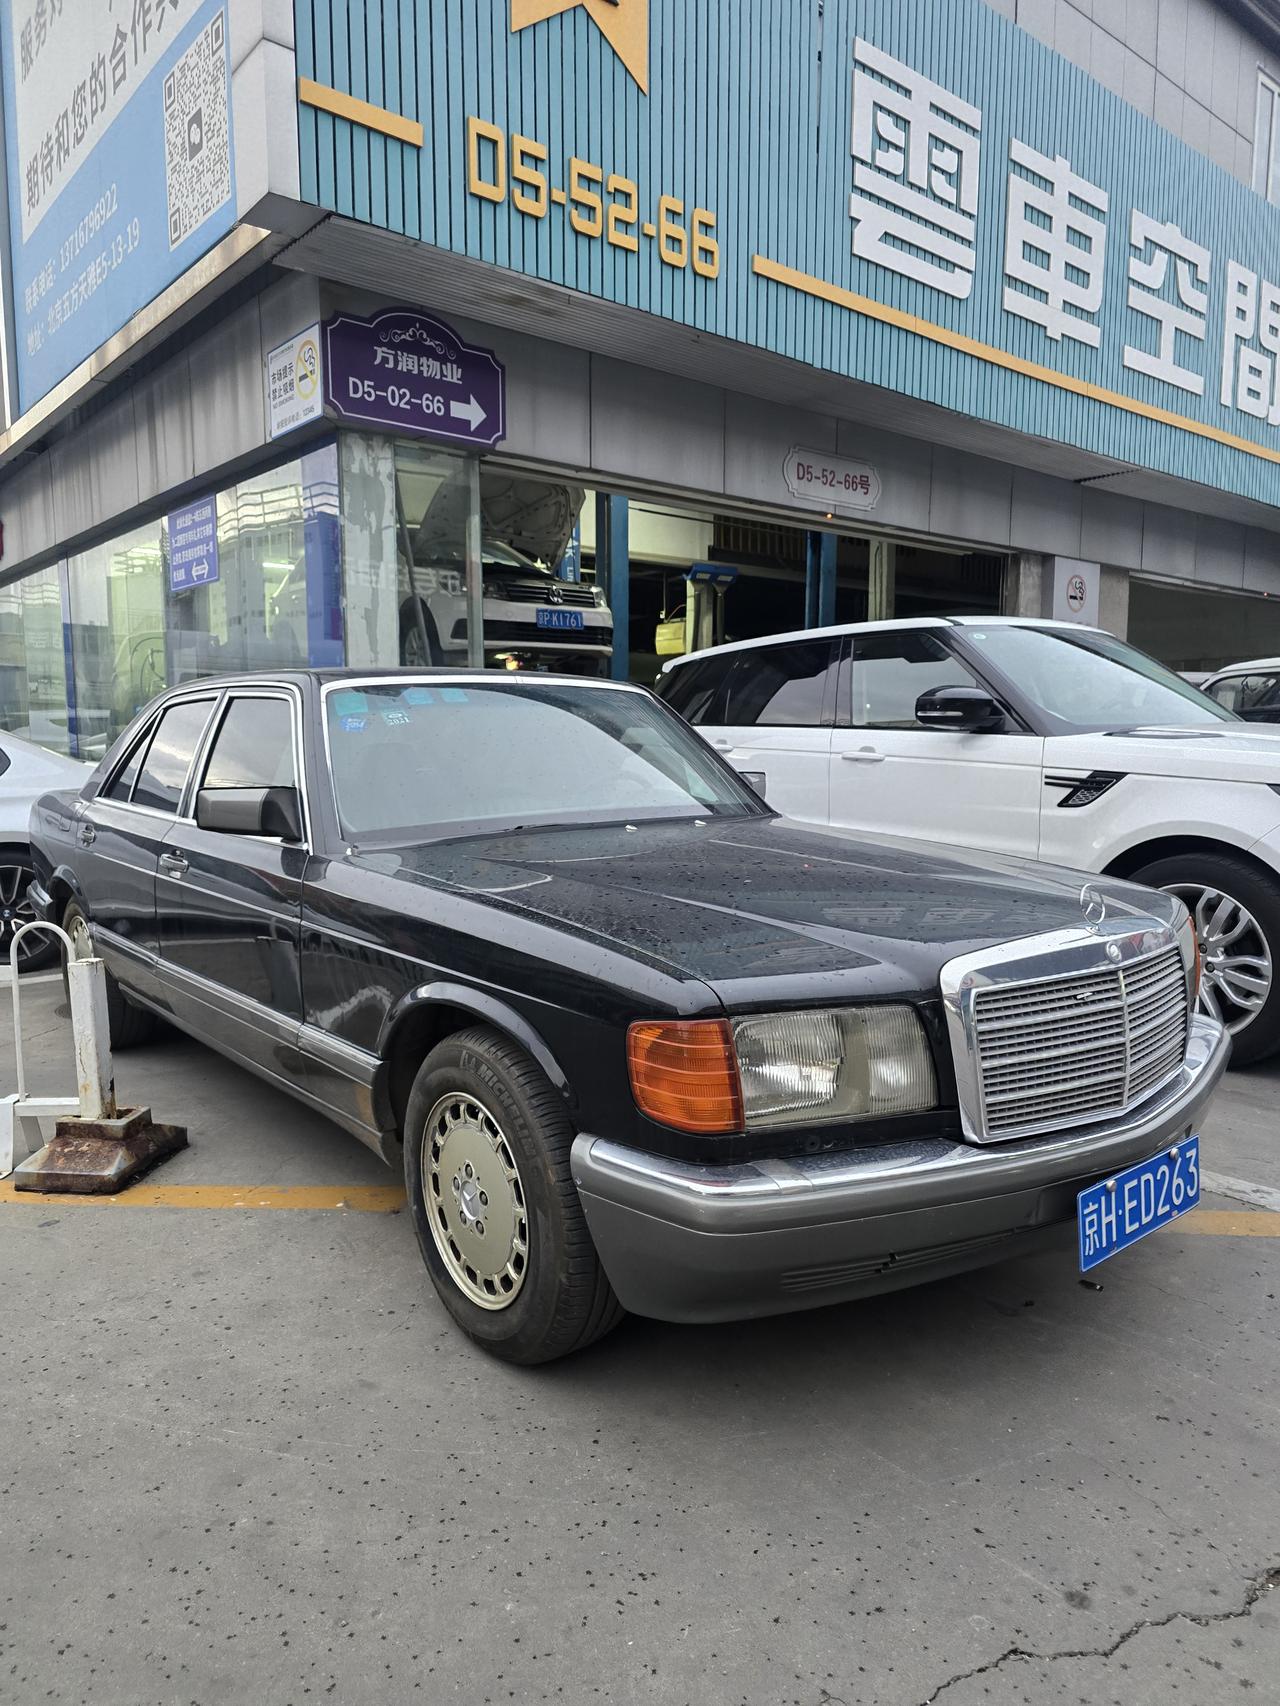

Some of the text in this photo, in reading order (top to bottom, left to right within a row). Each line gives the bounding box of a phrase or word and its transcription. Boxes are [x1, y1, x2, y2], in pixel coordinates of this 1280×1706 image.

[60, 183, 118, 273] 13716796922
[467, 116, 719, 279] D5-52-66
[348, 376, 445, 416] D5-02-66
[796, 462, 871, 495] D5-52-66号
